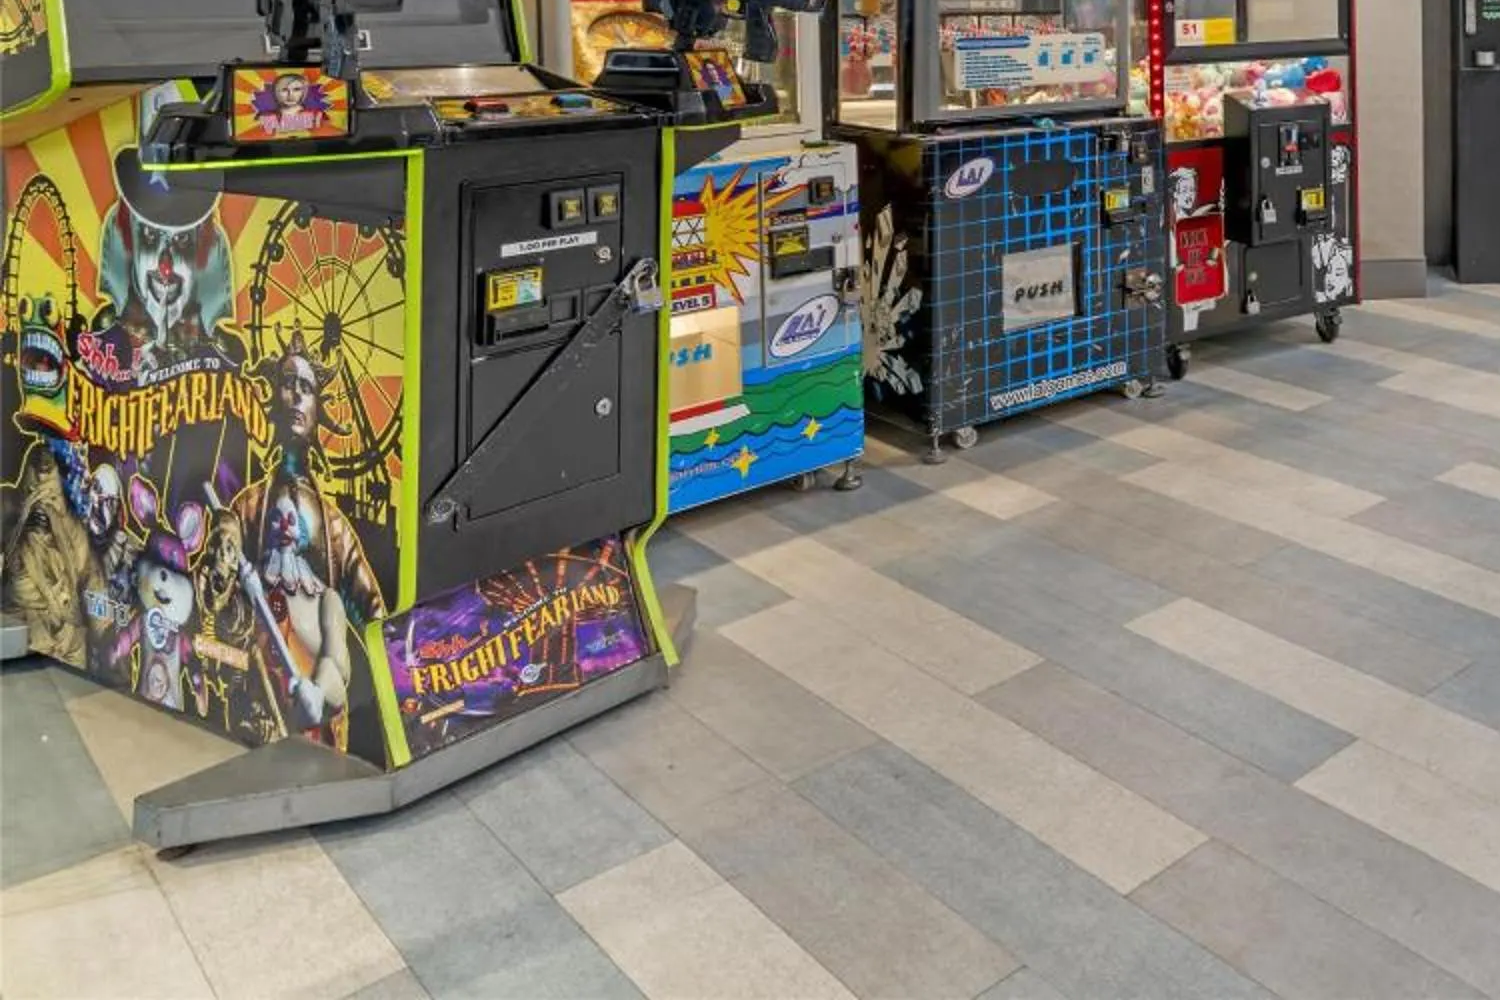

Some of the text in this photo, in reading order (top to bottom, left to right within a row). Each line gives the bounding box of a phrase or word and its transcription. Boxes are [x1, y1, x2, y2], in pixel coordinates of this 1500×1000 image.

[1014, 280, 1063, 303] PUSH
[672, 298, 700, 312] EVEL
[203, 357, 221, 370] TO
[66, 359, 268, 461] FRIGHTFEARLAND
[411, 583, 621, 696] FRIGHTFEARLAND
